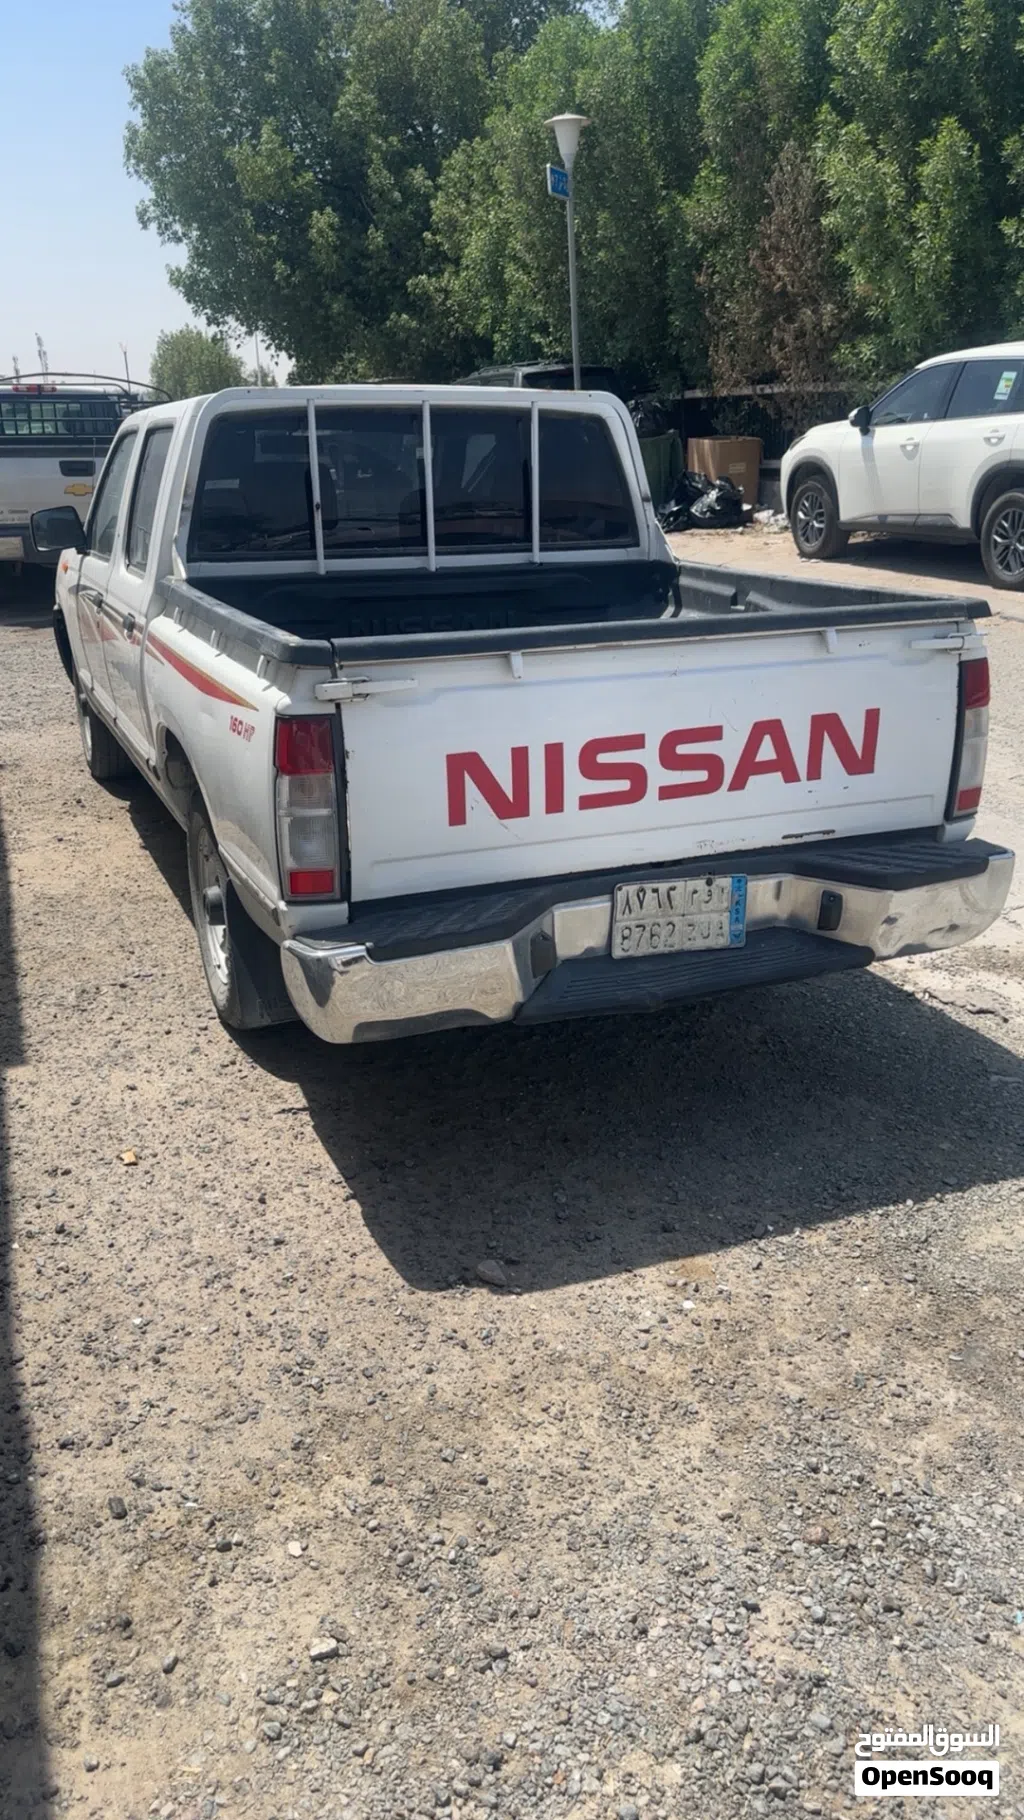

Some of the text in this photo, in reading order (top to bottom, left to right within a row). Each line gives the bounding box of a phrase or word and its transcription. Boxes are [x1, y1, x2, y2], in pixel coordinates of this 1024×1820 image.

[229, 714, 256, 743] 160 HP
[445, 707, 881, 827] NISSAN
[619, 920, 677, 953] 8762
